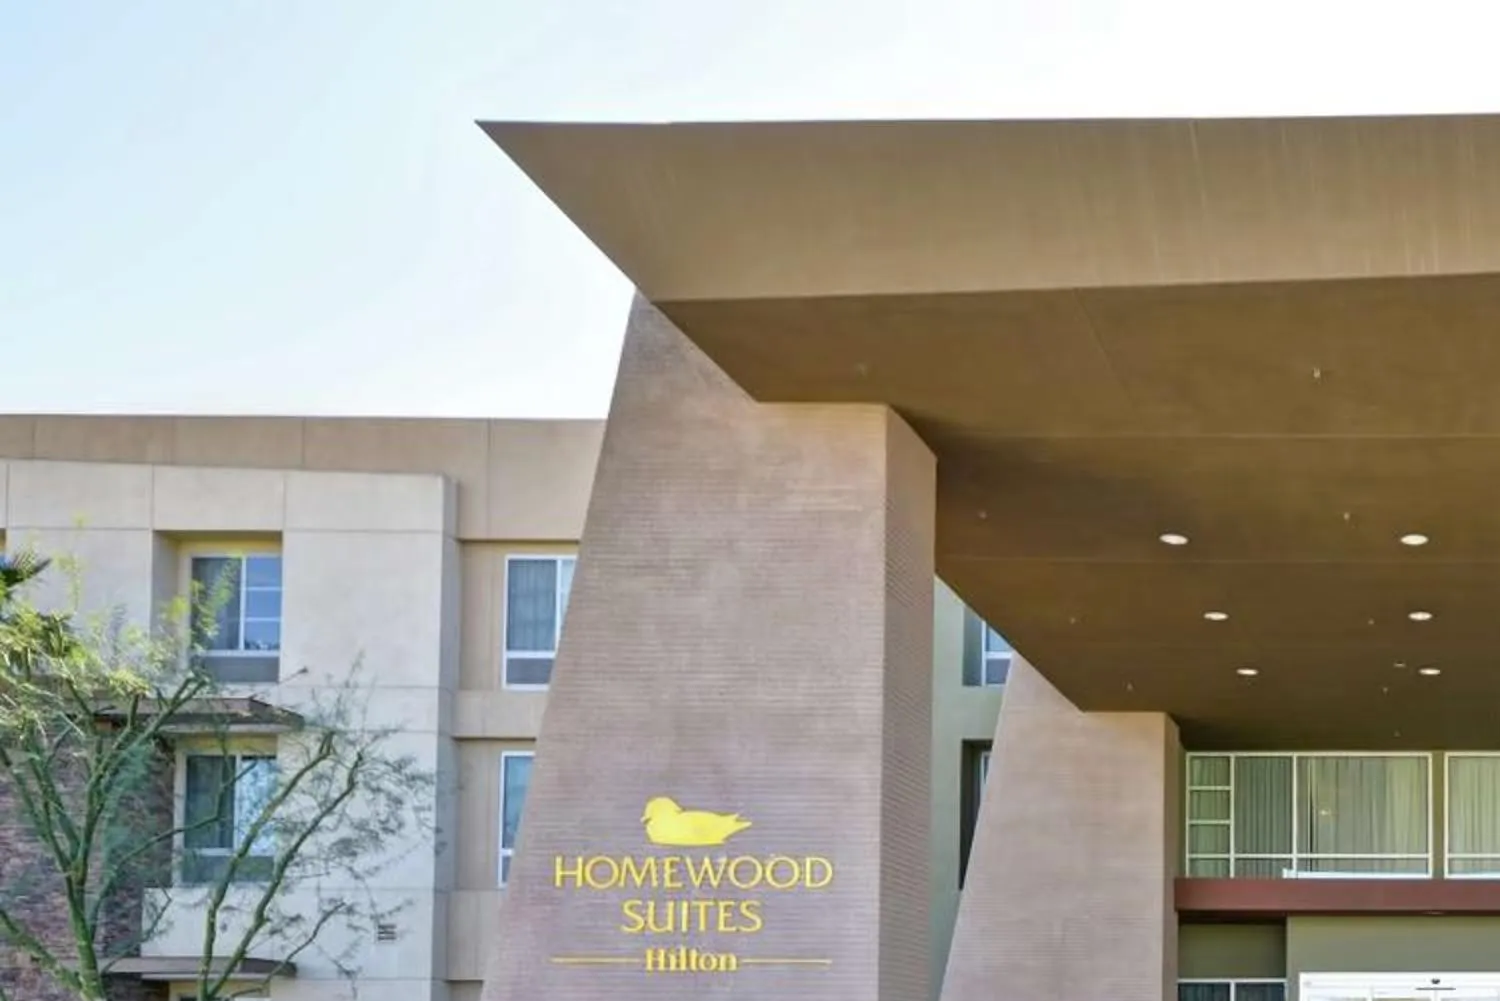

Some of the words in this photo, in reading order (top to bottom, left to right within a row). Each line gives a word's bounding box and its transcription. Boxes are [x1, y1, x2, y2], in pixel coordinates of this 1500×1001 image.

[554, 855, 833, 889] HOMEWOOD
[621, 899, 763, 933] SUITES
[645, 946, 738, 972] Hilton
